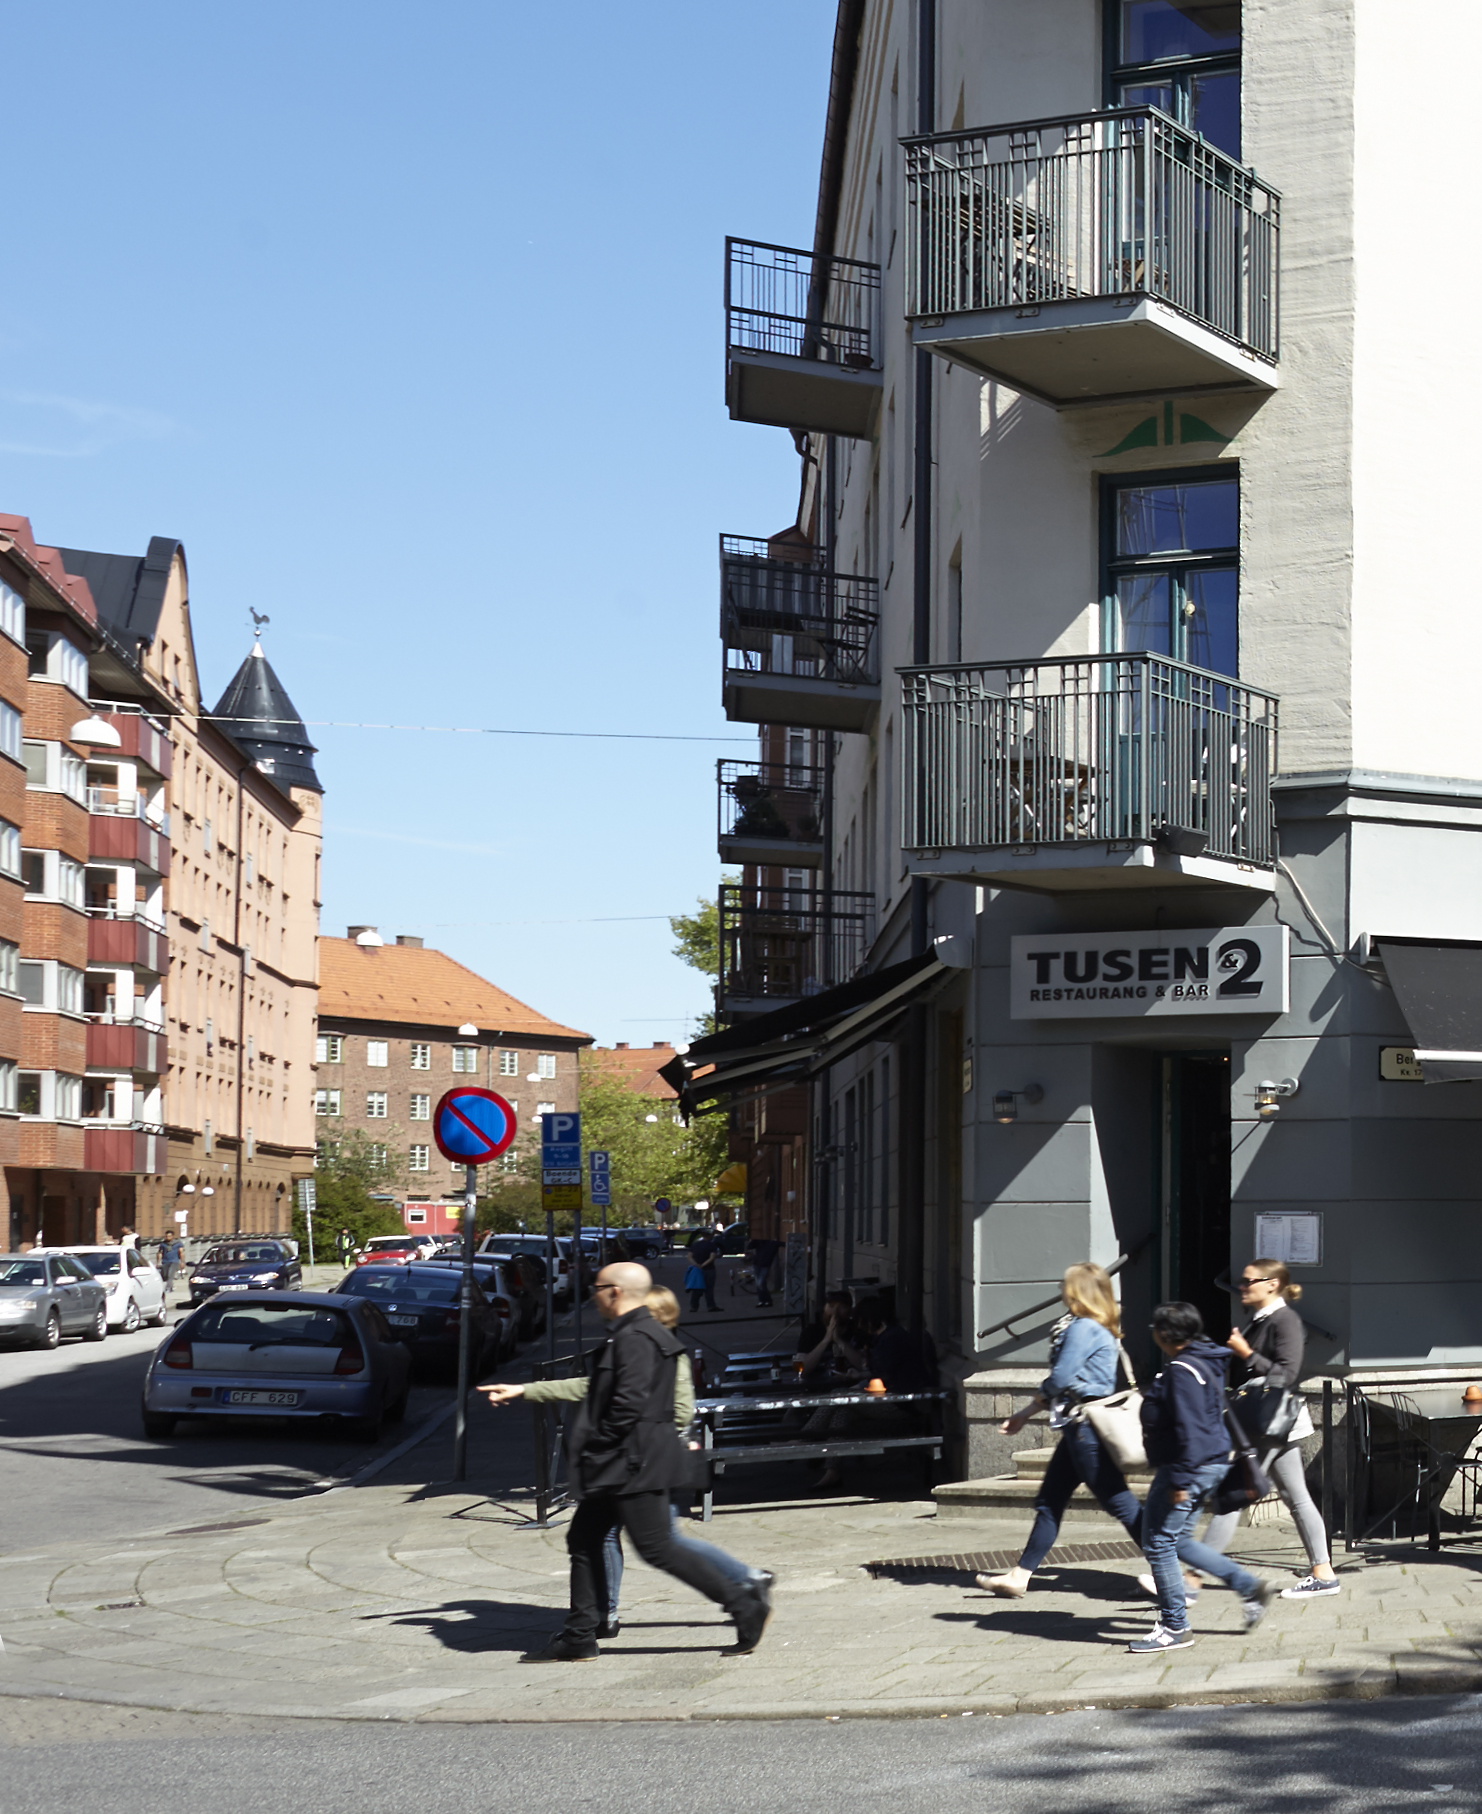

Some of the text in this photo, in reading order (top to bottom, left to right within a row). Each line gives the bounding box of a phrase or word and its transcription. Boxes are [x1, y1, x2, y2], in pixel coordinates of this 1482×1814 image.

[1027, 946, 1209, 985] TUSEN
[1219, 938, 1264, 996] 2
[1030, 984, 1209, 1002] RESTAURANG & BAR
[552, 1115, 574, 1141] P
[594, 1153, 606, 1170] P
[232, 1391, 295, 1404] CFF 629
